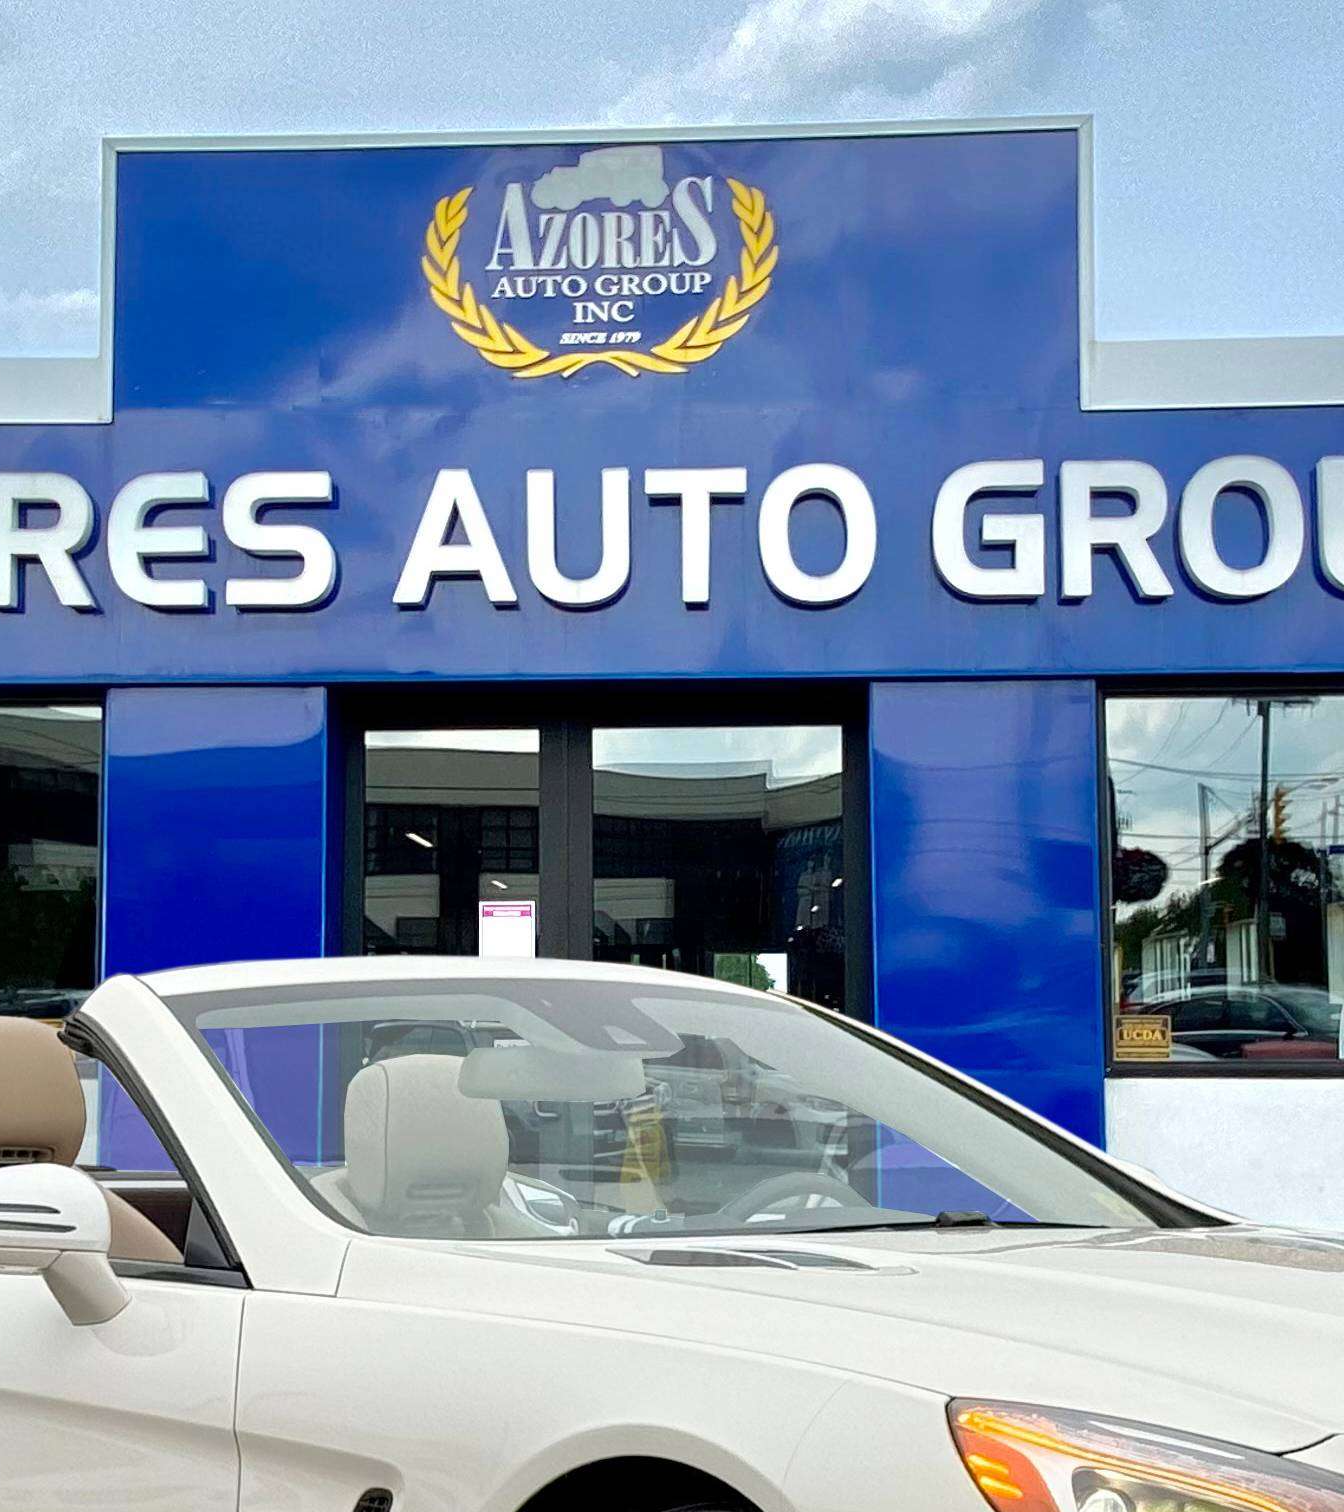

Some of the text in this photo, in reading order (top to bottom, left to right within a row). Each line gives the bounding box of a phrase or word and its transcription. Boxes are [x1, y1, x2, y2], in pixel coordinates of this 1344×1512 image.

[485, 175, 717, 271] AZORES
[491, 272, 712, 299] AUTO GROUP
[572, 301, 635, 324] INC
[559, 331, 642, 344] SINCE 1979
[393, 463, 877, 606] AUTO
[1122, 1029, 1164, 1041] UCDA
